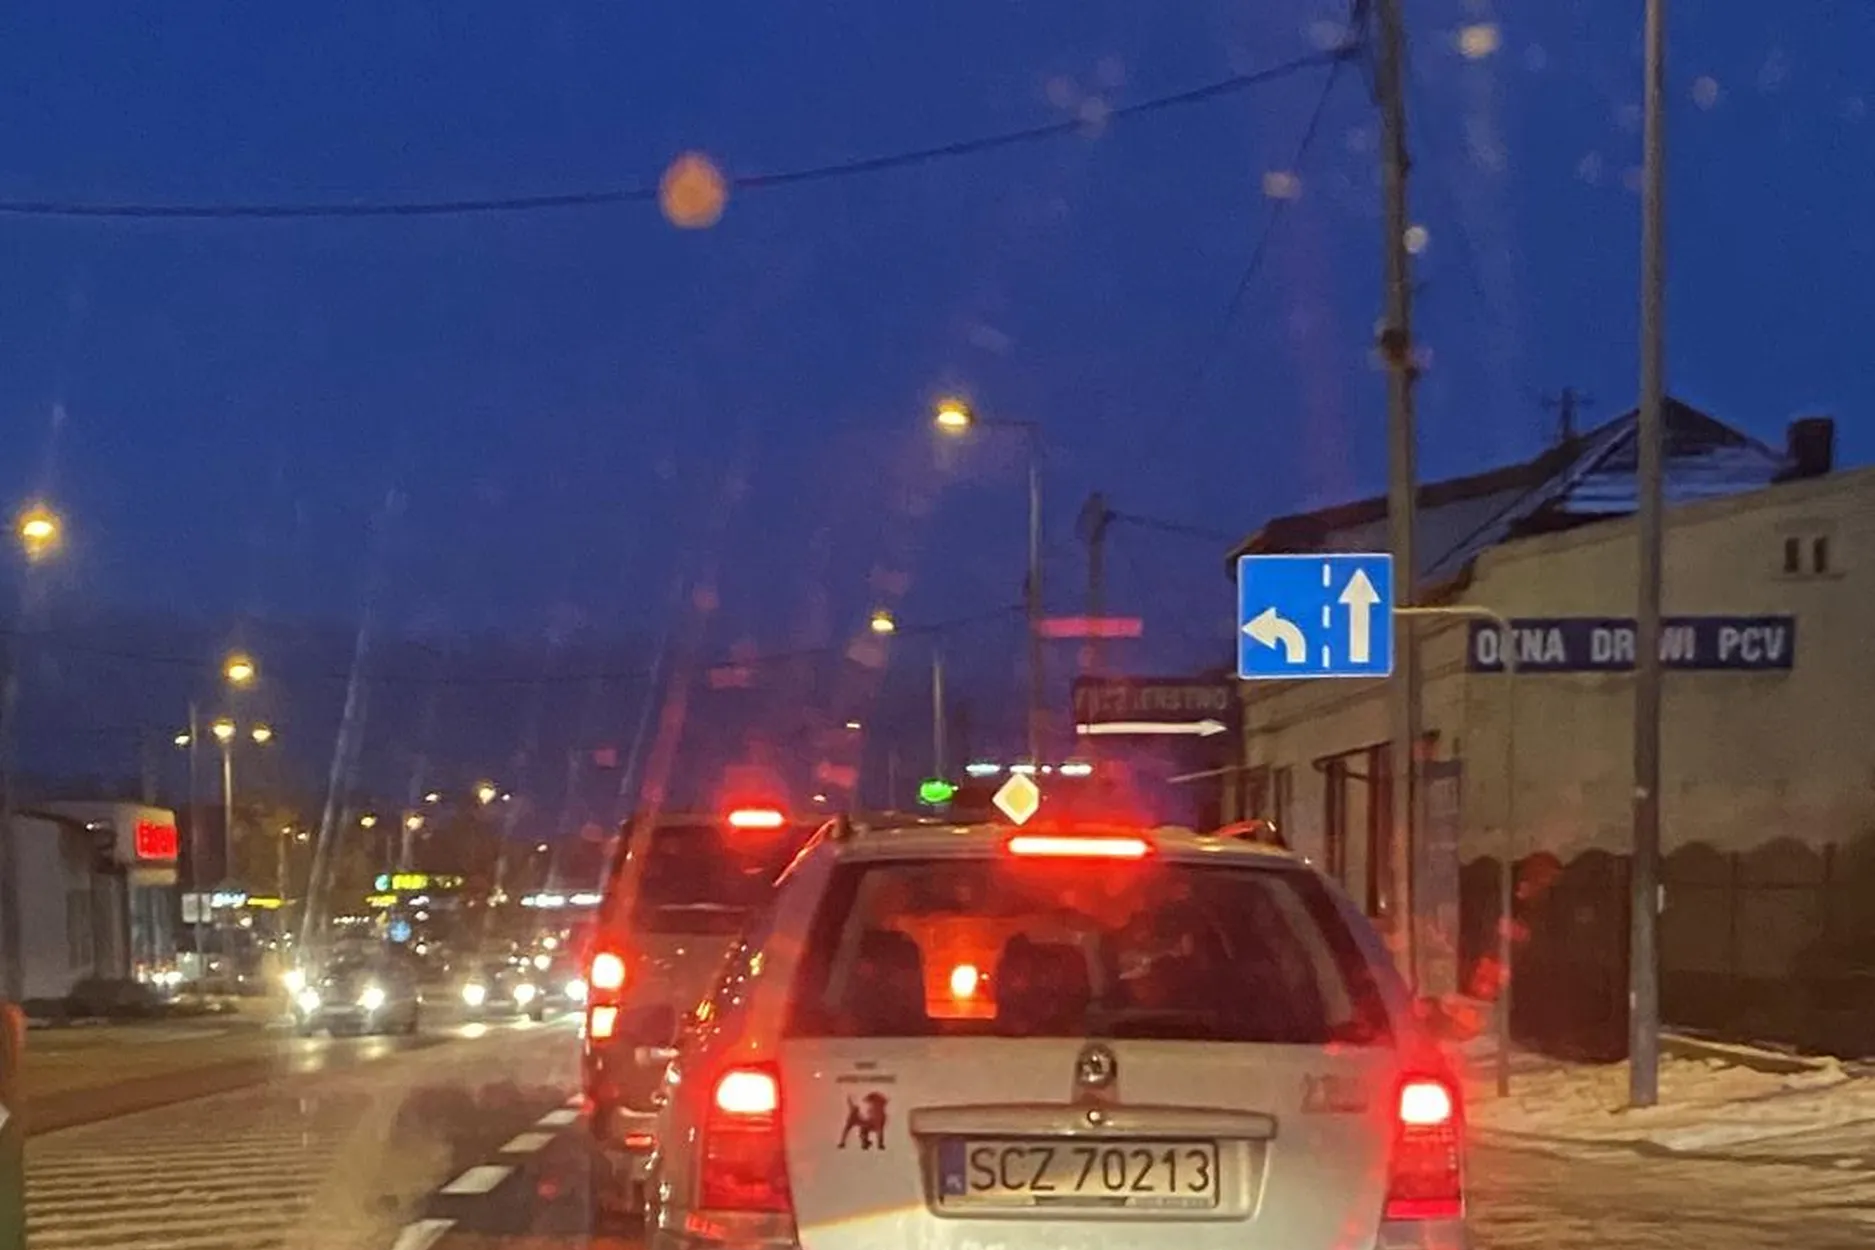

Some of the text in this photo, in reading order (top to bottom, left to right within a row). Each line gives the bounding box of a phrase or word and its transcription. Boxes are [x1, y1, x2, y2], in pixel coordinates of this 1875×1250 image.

[1591, 627, 1695, 662] DRWI
[1718, 626, 1785, 662] PCV
[970, 1148, 1210, 1193] SCZ 70213
